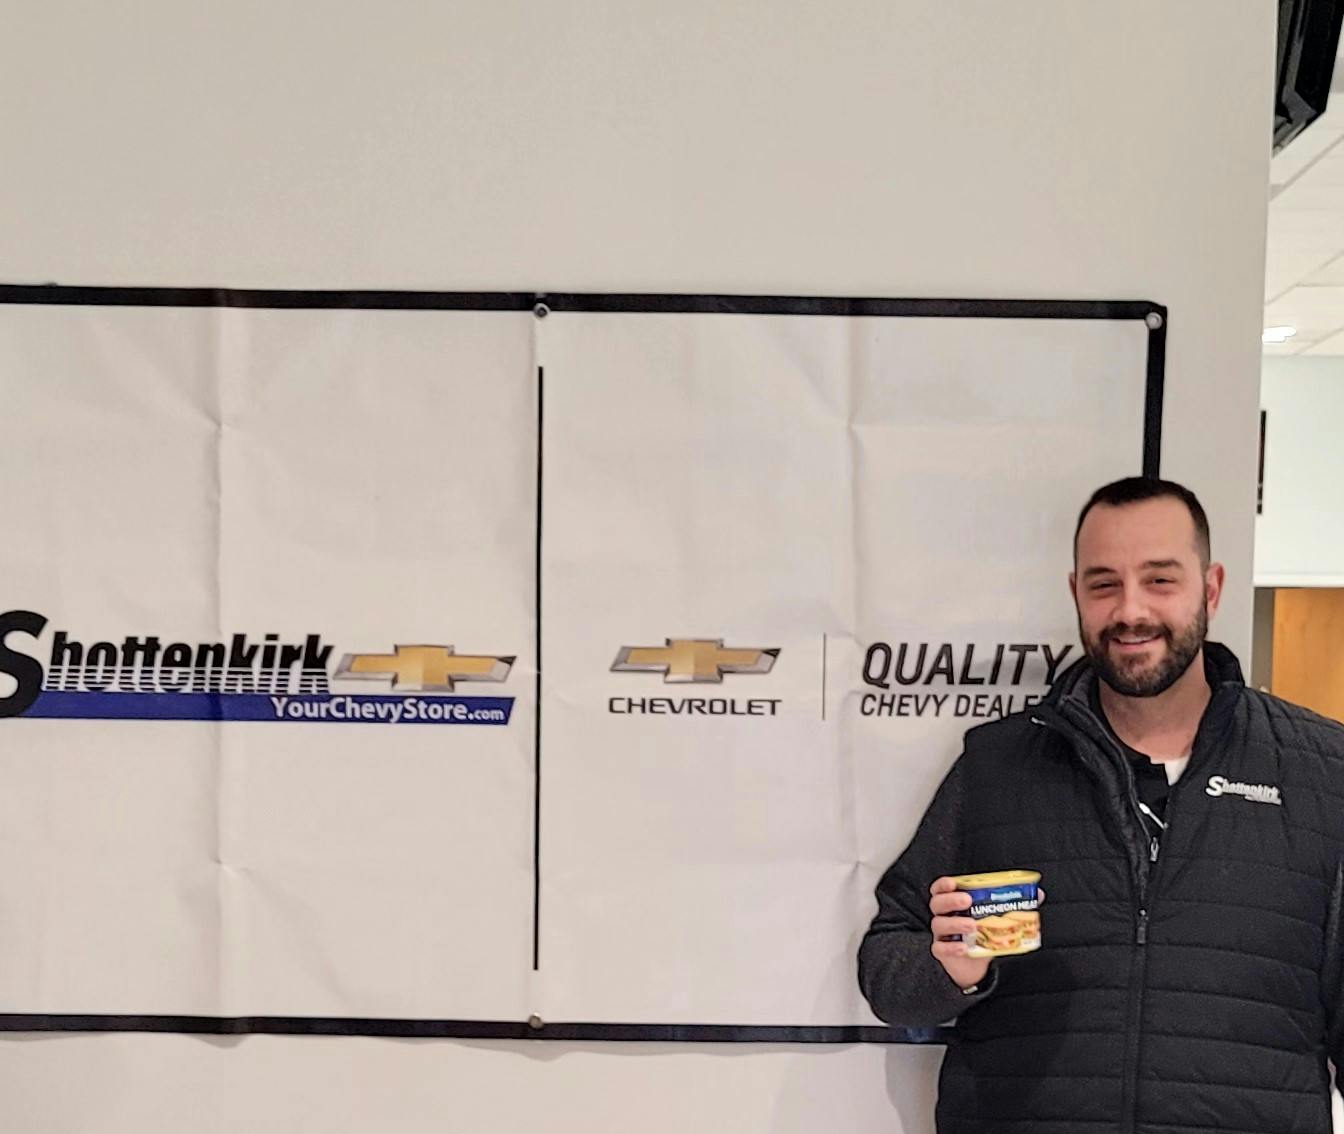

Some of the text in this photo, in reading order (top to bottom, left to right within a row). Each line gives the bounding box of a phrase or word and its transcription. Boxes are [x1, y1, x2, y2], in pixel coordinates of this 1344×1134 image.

[862, 642, 1074, 689] QUALITY
[271, 697, 505, 723] YourChevyStore.com
[608, 697, 782, 716] CHEVROLET
[860, 693, 949, 717] CHEVY
